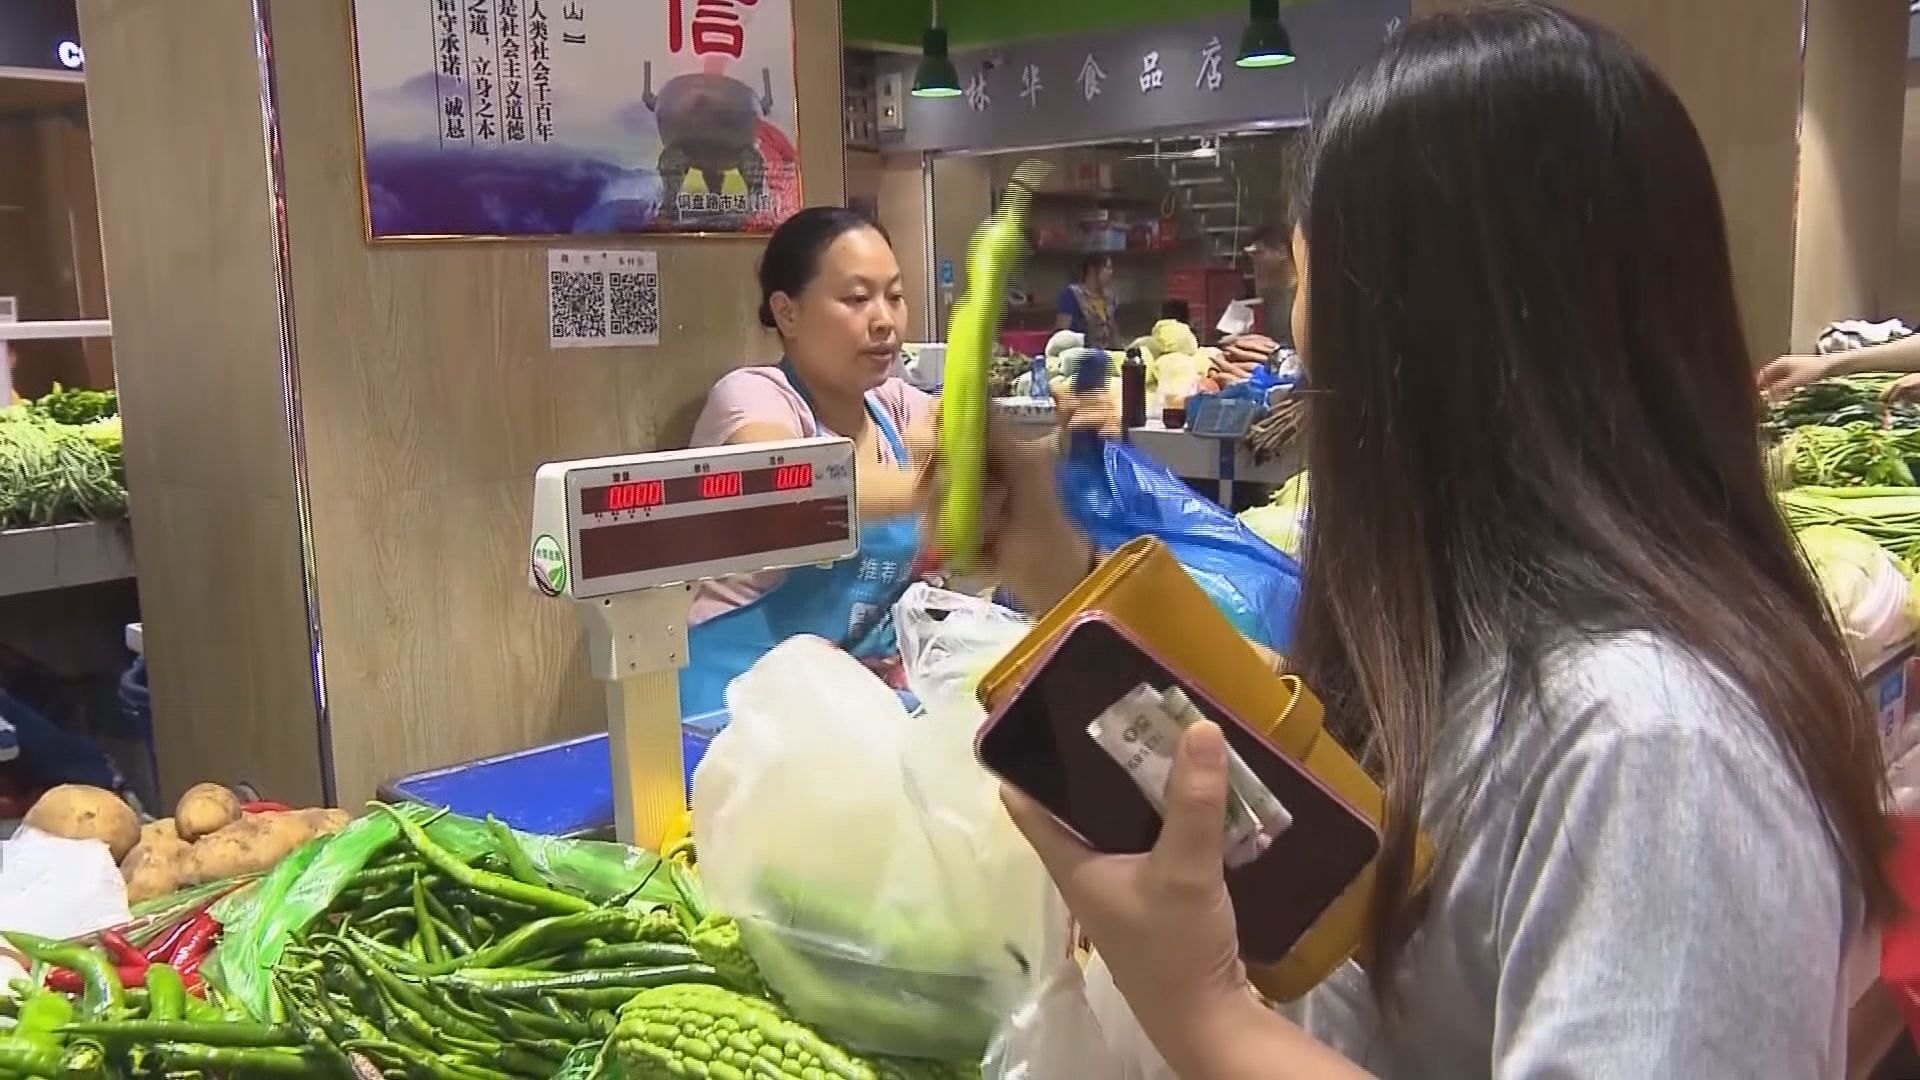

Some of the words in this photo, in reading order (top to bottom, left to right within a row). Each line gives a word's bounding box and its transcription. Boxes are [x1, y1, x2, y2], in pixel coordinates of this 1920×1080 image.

[666, 0, 758, 58] 信
[529, 0, 554, 142] 人类社会千百年
[964, 37, 1223, 112] 林华食品店
[609, 482, 661, 510] 0.000
[703, 473, 738, 497] 0.00
